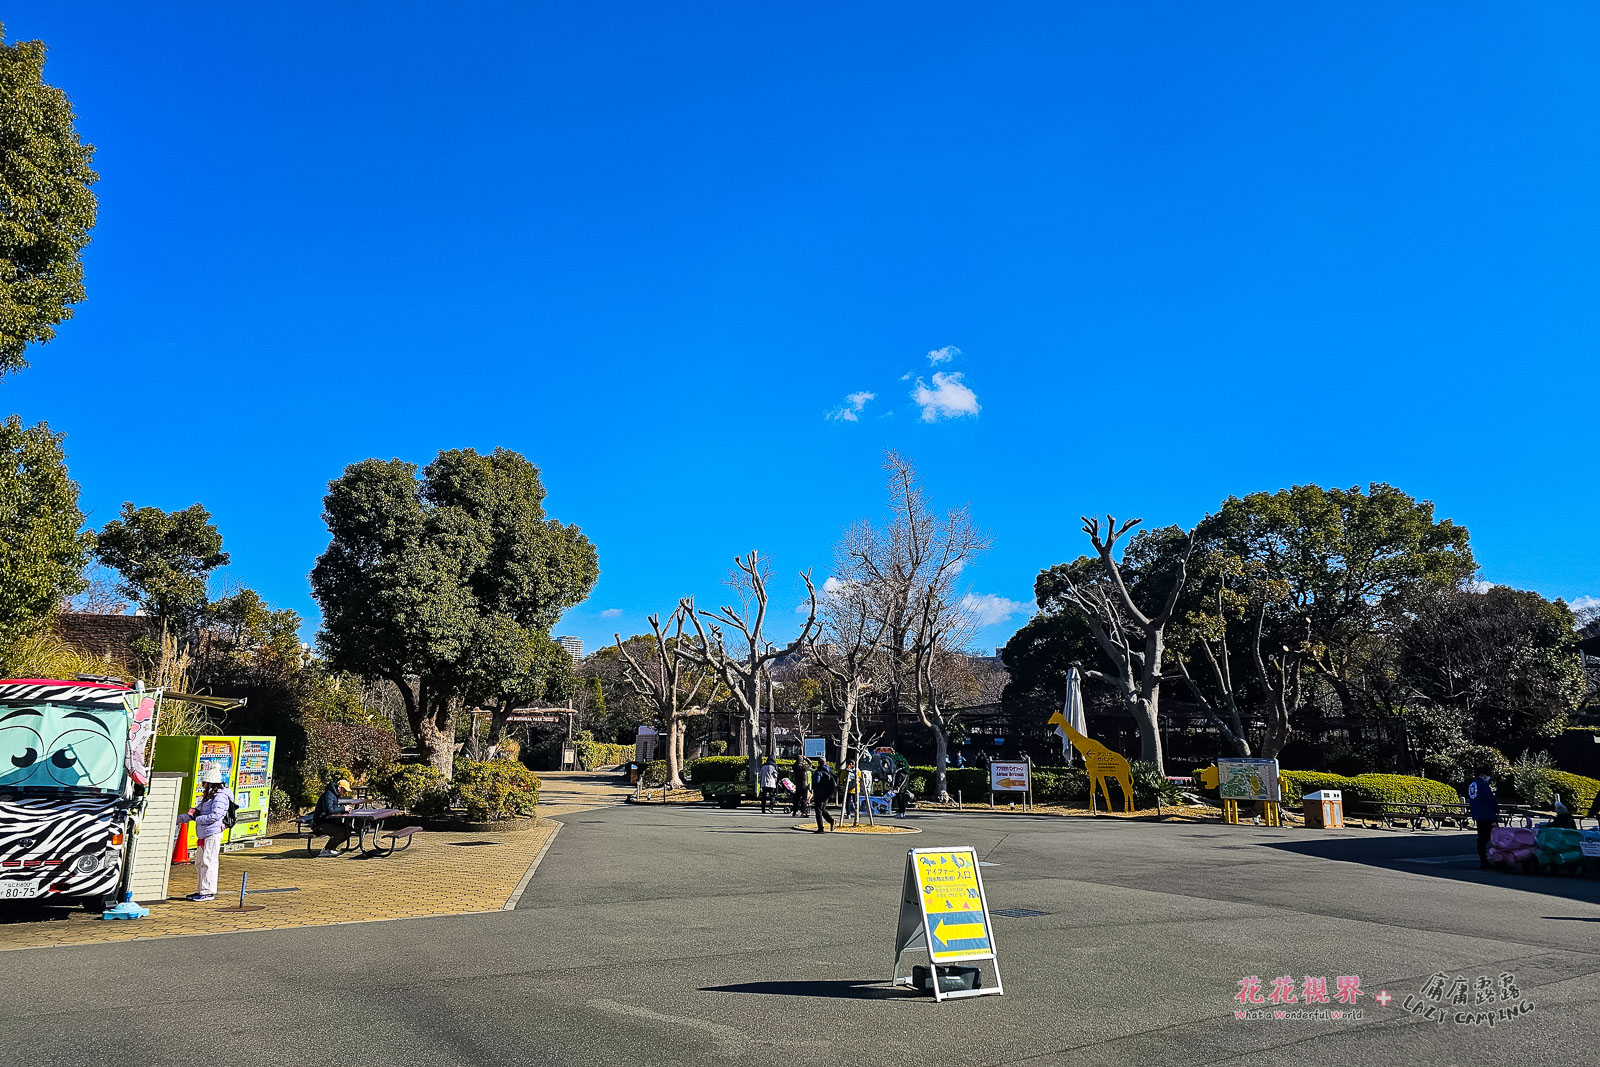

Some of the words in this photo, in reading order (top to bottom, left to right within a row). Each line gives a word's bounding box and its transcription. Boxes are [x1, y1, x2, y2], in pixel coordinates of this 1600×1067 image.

[926, 868, 954, 876] アイファー
[957, 870, 972, 880] 入口
[6, 888, 35, 897] 80-75
